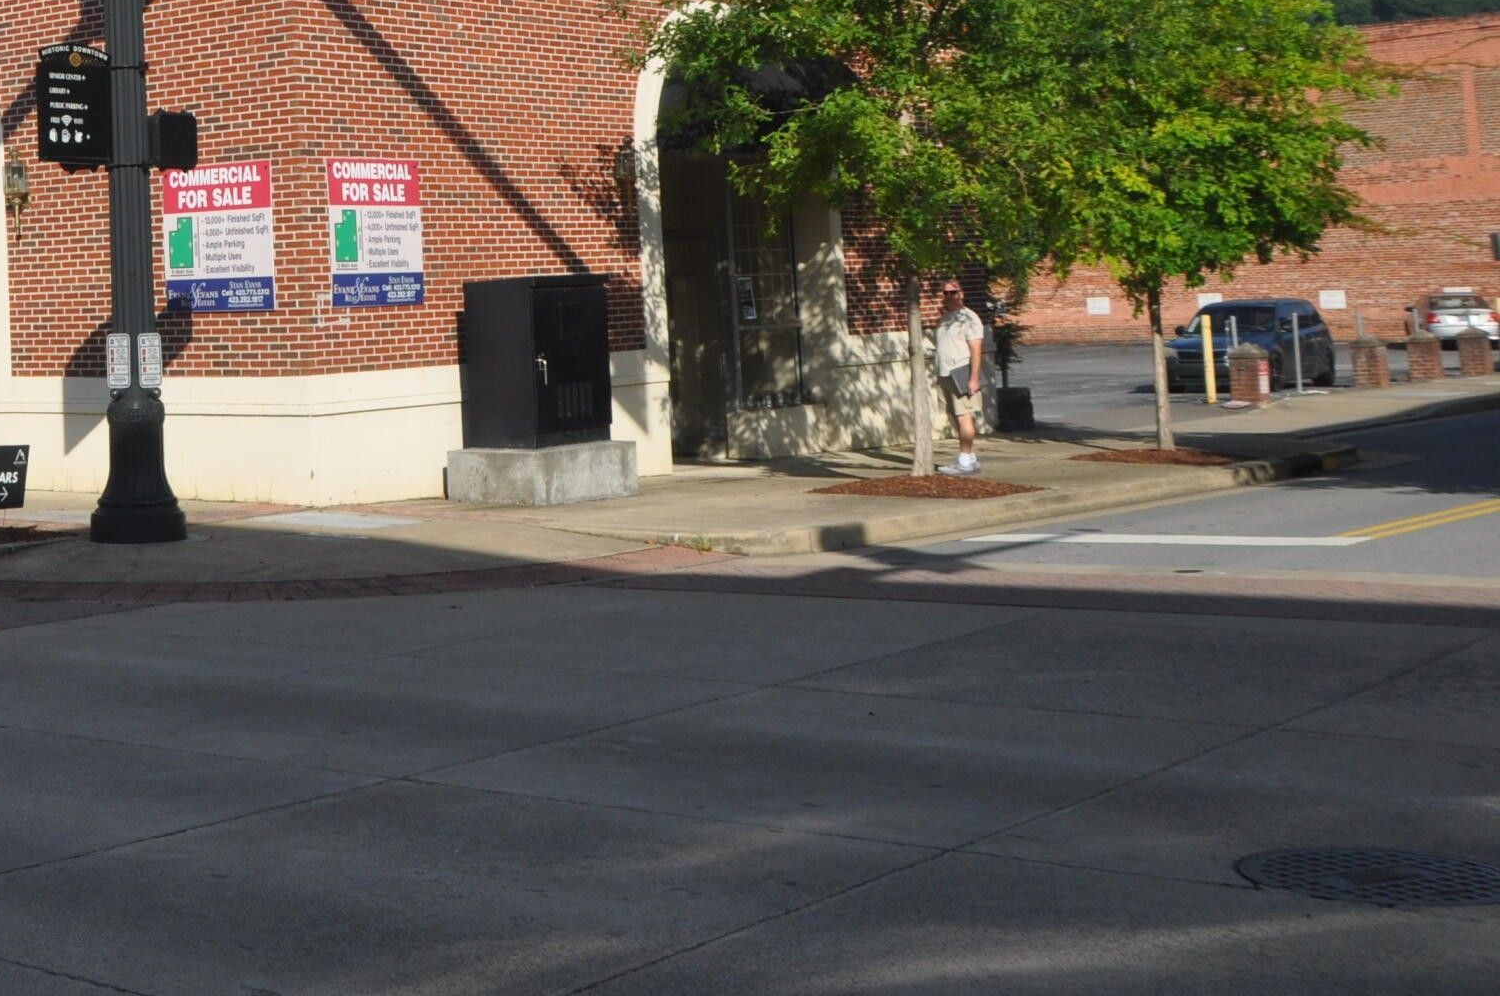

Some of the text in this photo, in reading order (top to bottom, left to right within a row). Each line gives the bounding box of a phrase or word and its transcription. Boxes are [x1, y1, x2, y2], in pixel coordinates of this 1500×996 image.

[41, 45, 109, 61] HISTORIC DOWNTOWN
[66, 73, 81, 81] CENTER
[169, 164, 261, 188] COMMERCIAL
[332, 161, 412, 181] COMMERCIAL
[341, 182, 406, 202] FOR SALE
[177, 186, 252, 210] FOR SALE
[227, 214, 250, 223] Finished
[252, 212, 266, 224] SqFt
[386, 210, 405, 219] Finished
[406, 210, 416, 219] SqFt
[225, 226, 255, 236] Unfinished
[255, 225, 269, 235] SqFt
[385, 222, 408, 231] Unfinished
[205, 239, 245, 250] Ample Parking
[368, 235, 383, 244] Ample
[383, 234, 402, 246] Parking
[368, 247, 399, 256] Multiple Uses
[205, 252, 242, 263] Multiple Uses
[205, 263, 255, 274] Excellent Visibility
[368, 259, 410, 270] Excellent Visibility
[197, 289, 219, 298] EVANS
[360, 285, 380, 294] EVANS
